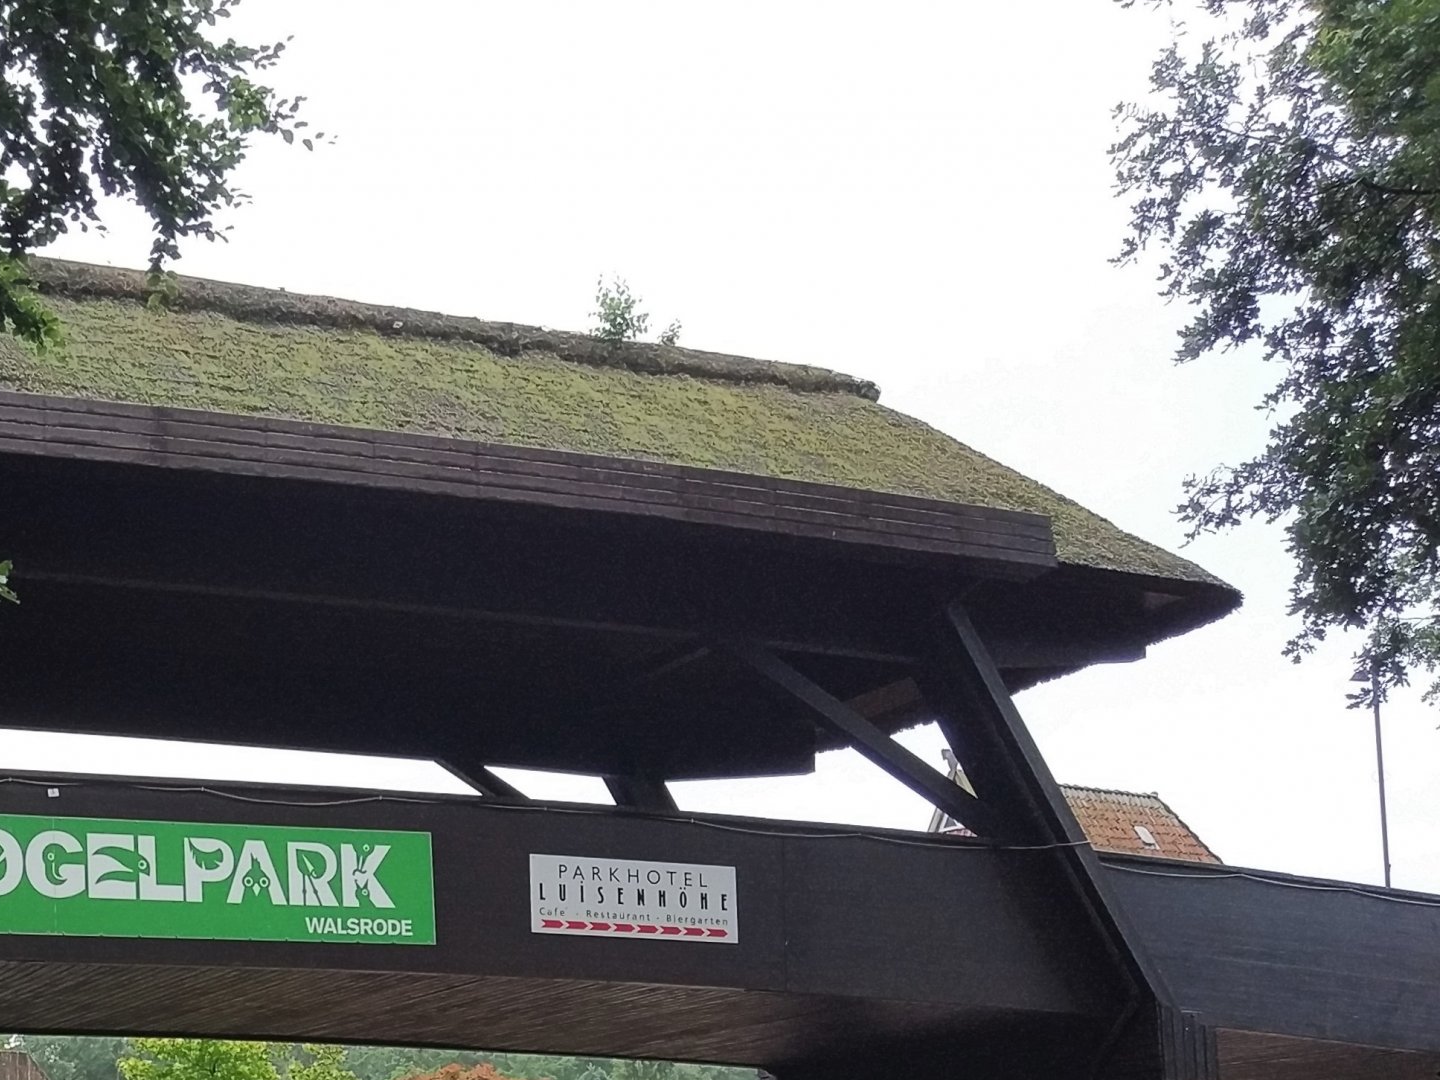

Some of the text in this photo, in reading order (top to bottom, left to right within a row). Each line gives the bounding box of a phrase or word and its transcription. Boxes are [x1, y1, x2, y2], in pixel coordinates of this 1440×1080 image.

[558, 864, 708, 888] PARKHOTEL
[305, 917, 413, 936] WALSRODE
[585, 909, 651, 922] Restaurant
[666, 914, 728, 926] Biergarten
